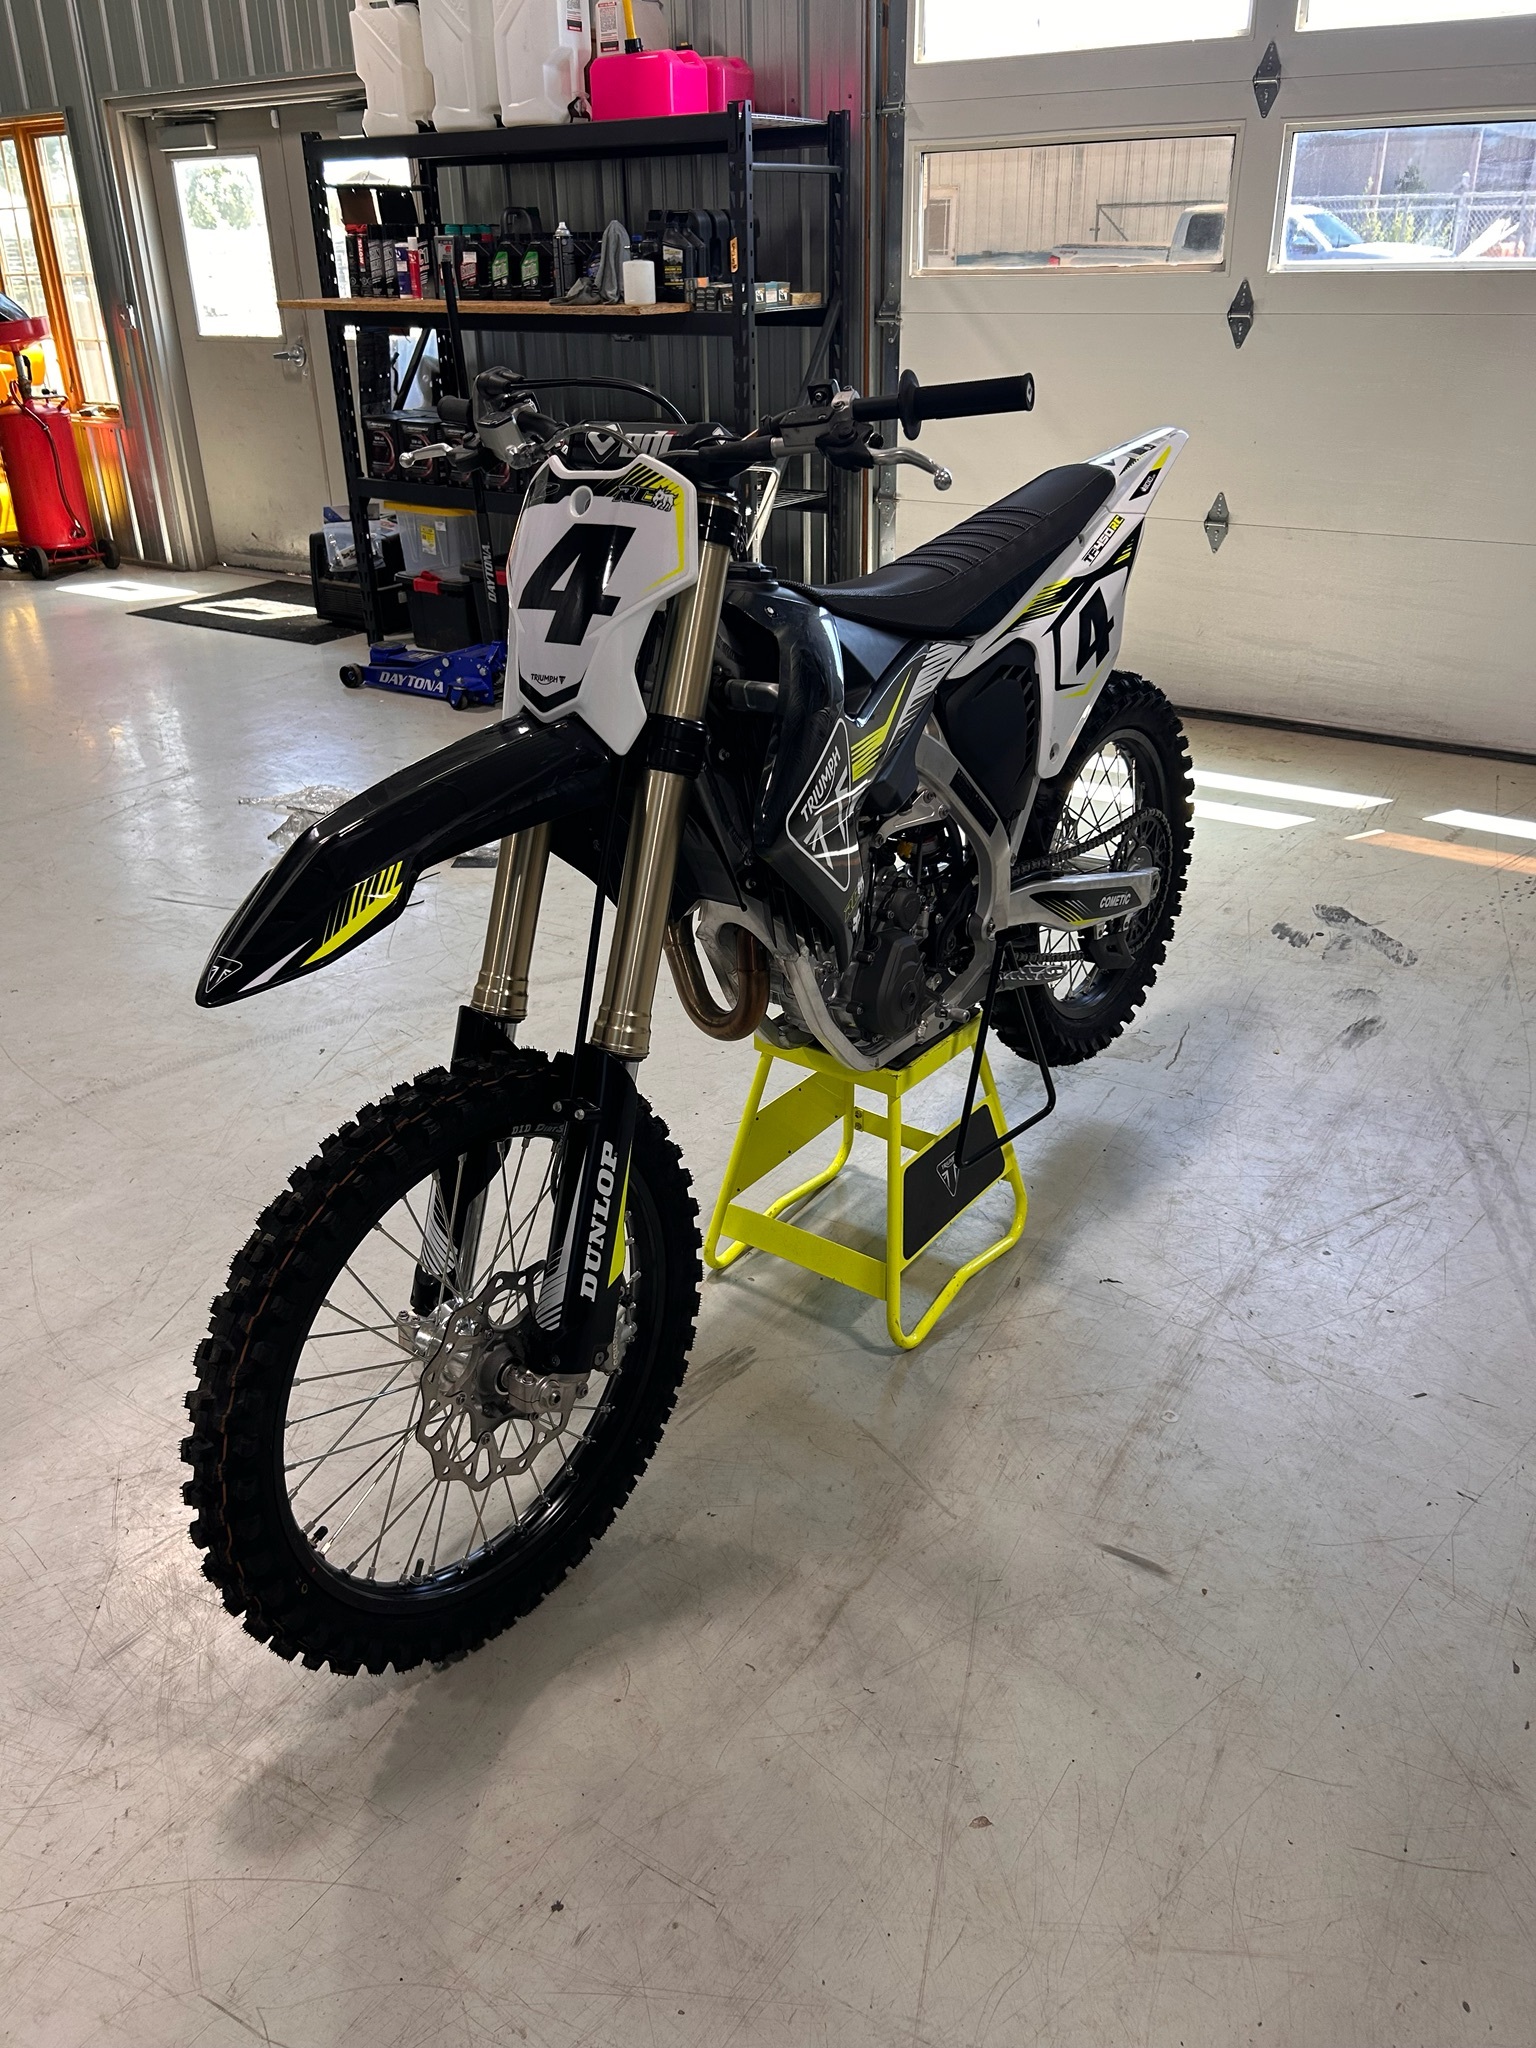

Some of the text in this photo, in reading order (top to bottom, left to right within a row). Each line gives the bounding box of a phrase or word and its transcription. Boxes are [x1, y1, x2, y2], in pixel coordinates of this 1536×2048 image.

[357, 237, 365, 265] MOTUL
[1083, 514, 1125, 565] TF450RC
[481, 544, 497, 603] DAYTONA
[518, 523, 636, 646] 4
[1076, 586, 1114, 676] 4
[379, 670, 444, 694] DAYTONA
[530, 673, 559, 686] TRIUMPH
[800, 745, 841, 822] TRIUMPH
[1099, 892, 1132, 909] COMETIC
[580, 1140, 617, 1302] DUNLOP
